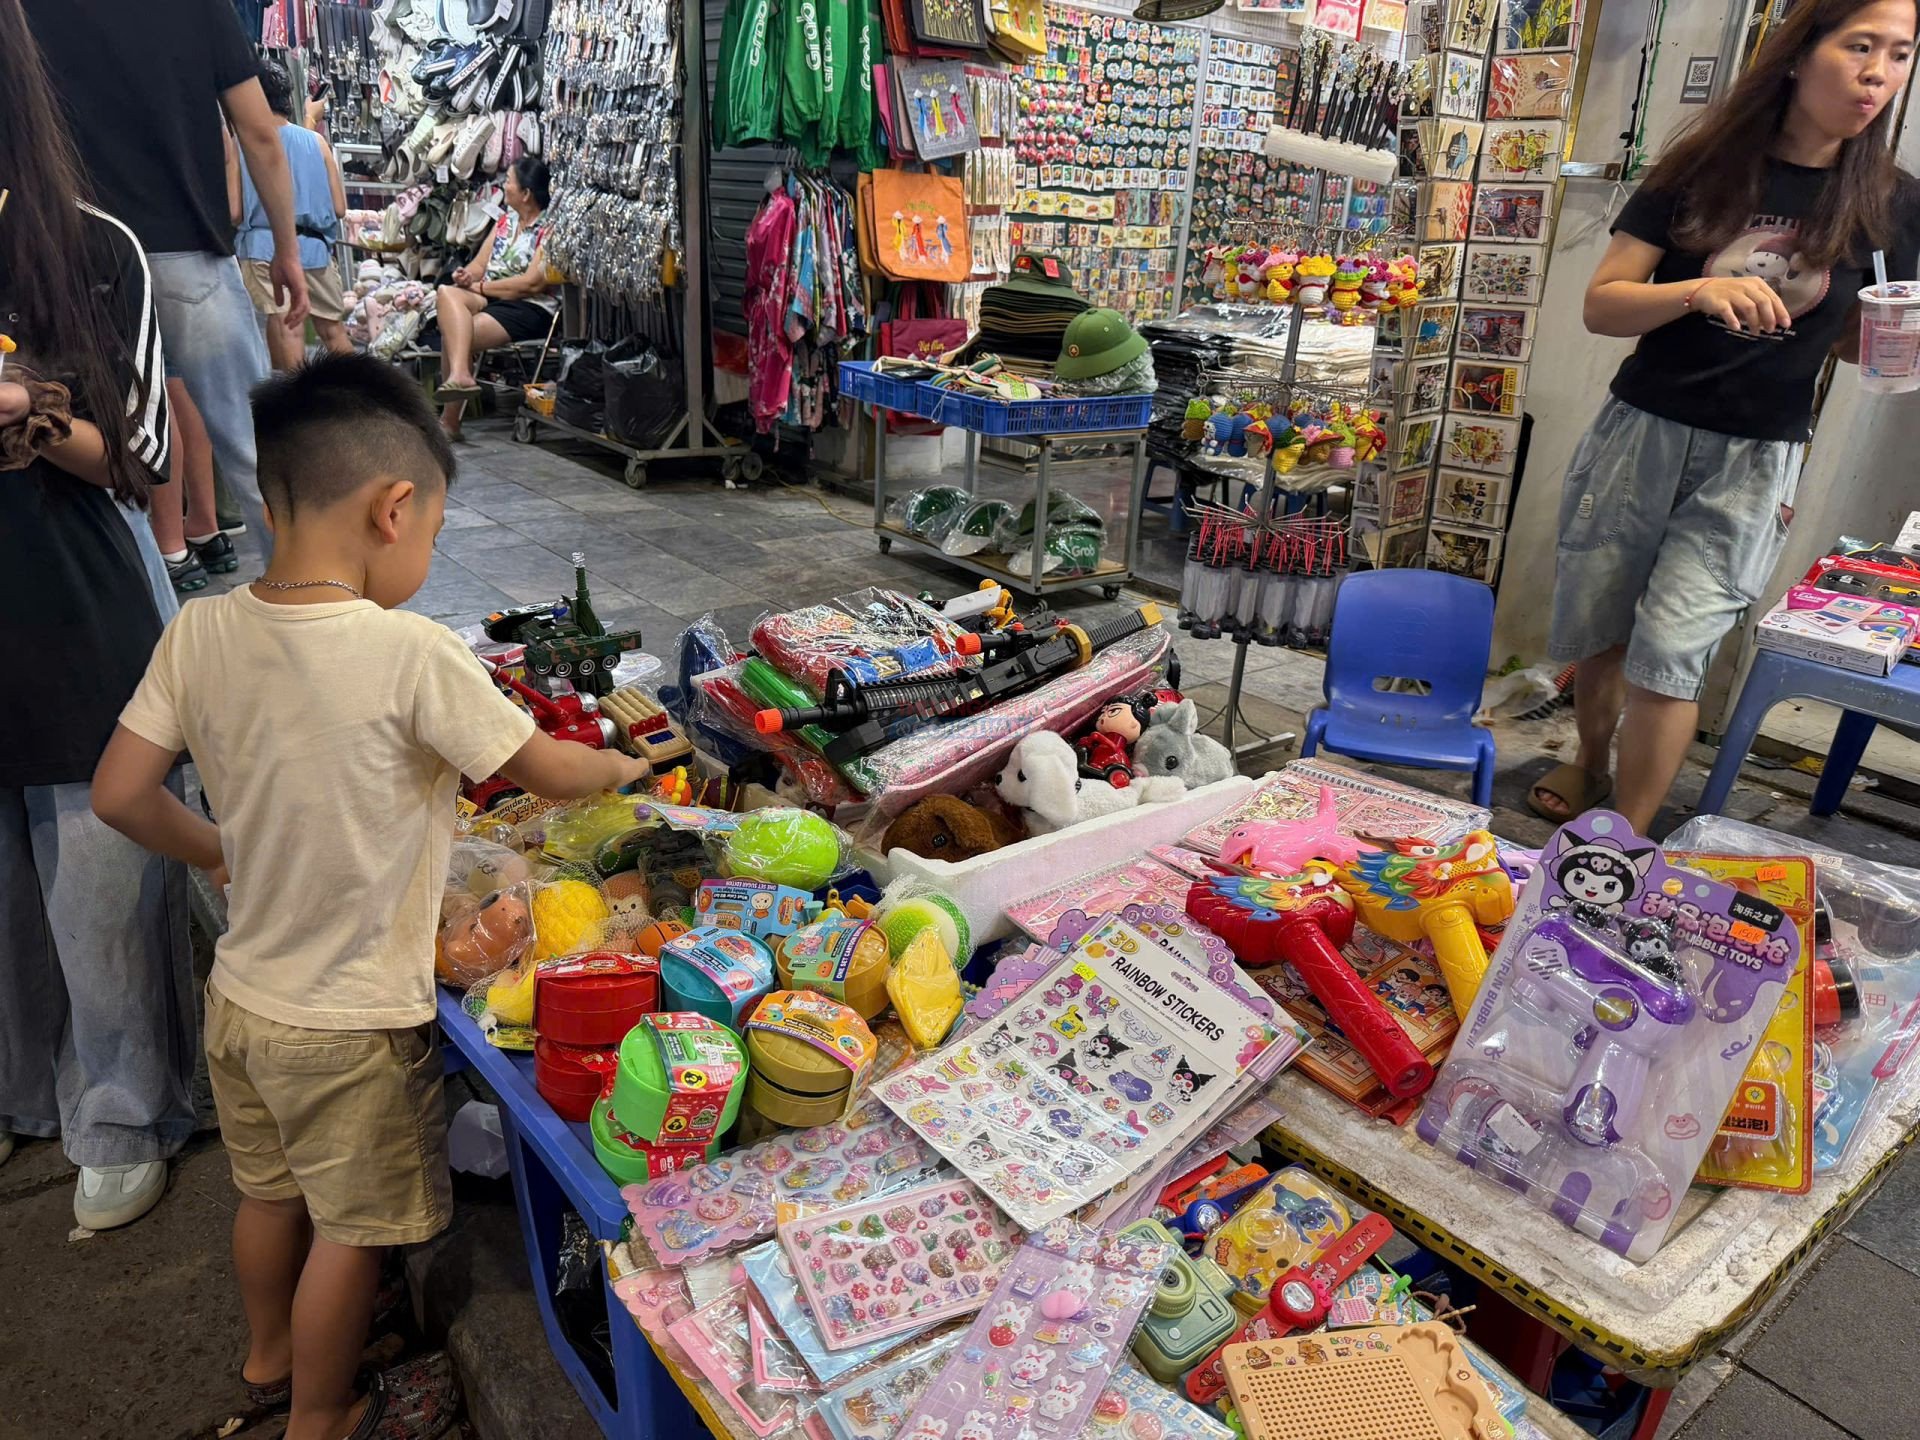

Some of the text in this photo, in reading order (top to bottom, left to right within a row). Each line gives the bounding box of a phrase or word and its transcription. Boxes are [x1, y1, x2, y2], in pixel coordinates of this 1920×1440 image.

[796, 2, 822, 71] Grab
[460, 60, 479, 78] crocs
[490, 71, 505, 97] crocs
[1108, 929, 1139, 954] 3D
[840, 959, 849, 968] SET
[1728, 948, 1764, 970] TOYS
[836, 970, 845, 979] ONE
[1111, 956, 1168, 999] RAINBOW
[1162, 993, 1225, 1042] STICKERS
[771, 1024, 789, 1033] SUGAR
[789, 1028, 812, 1041] EDITION
[1337, 1227, 1377, 1266] KITTY
